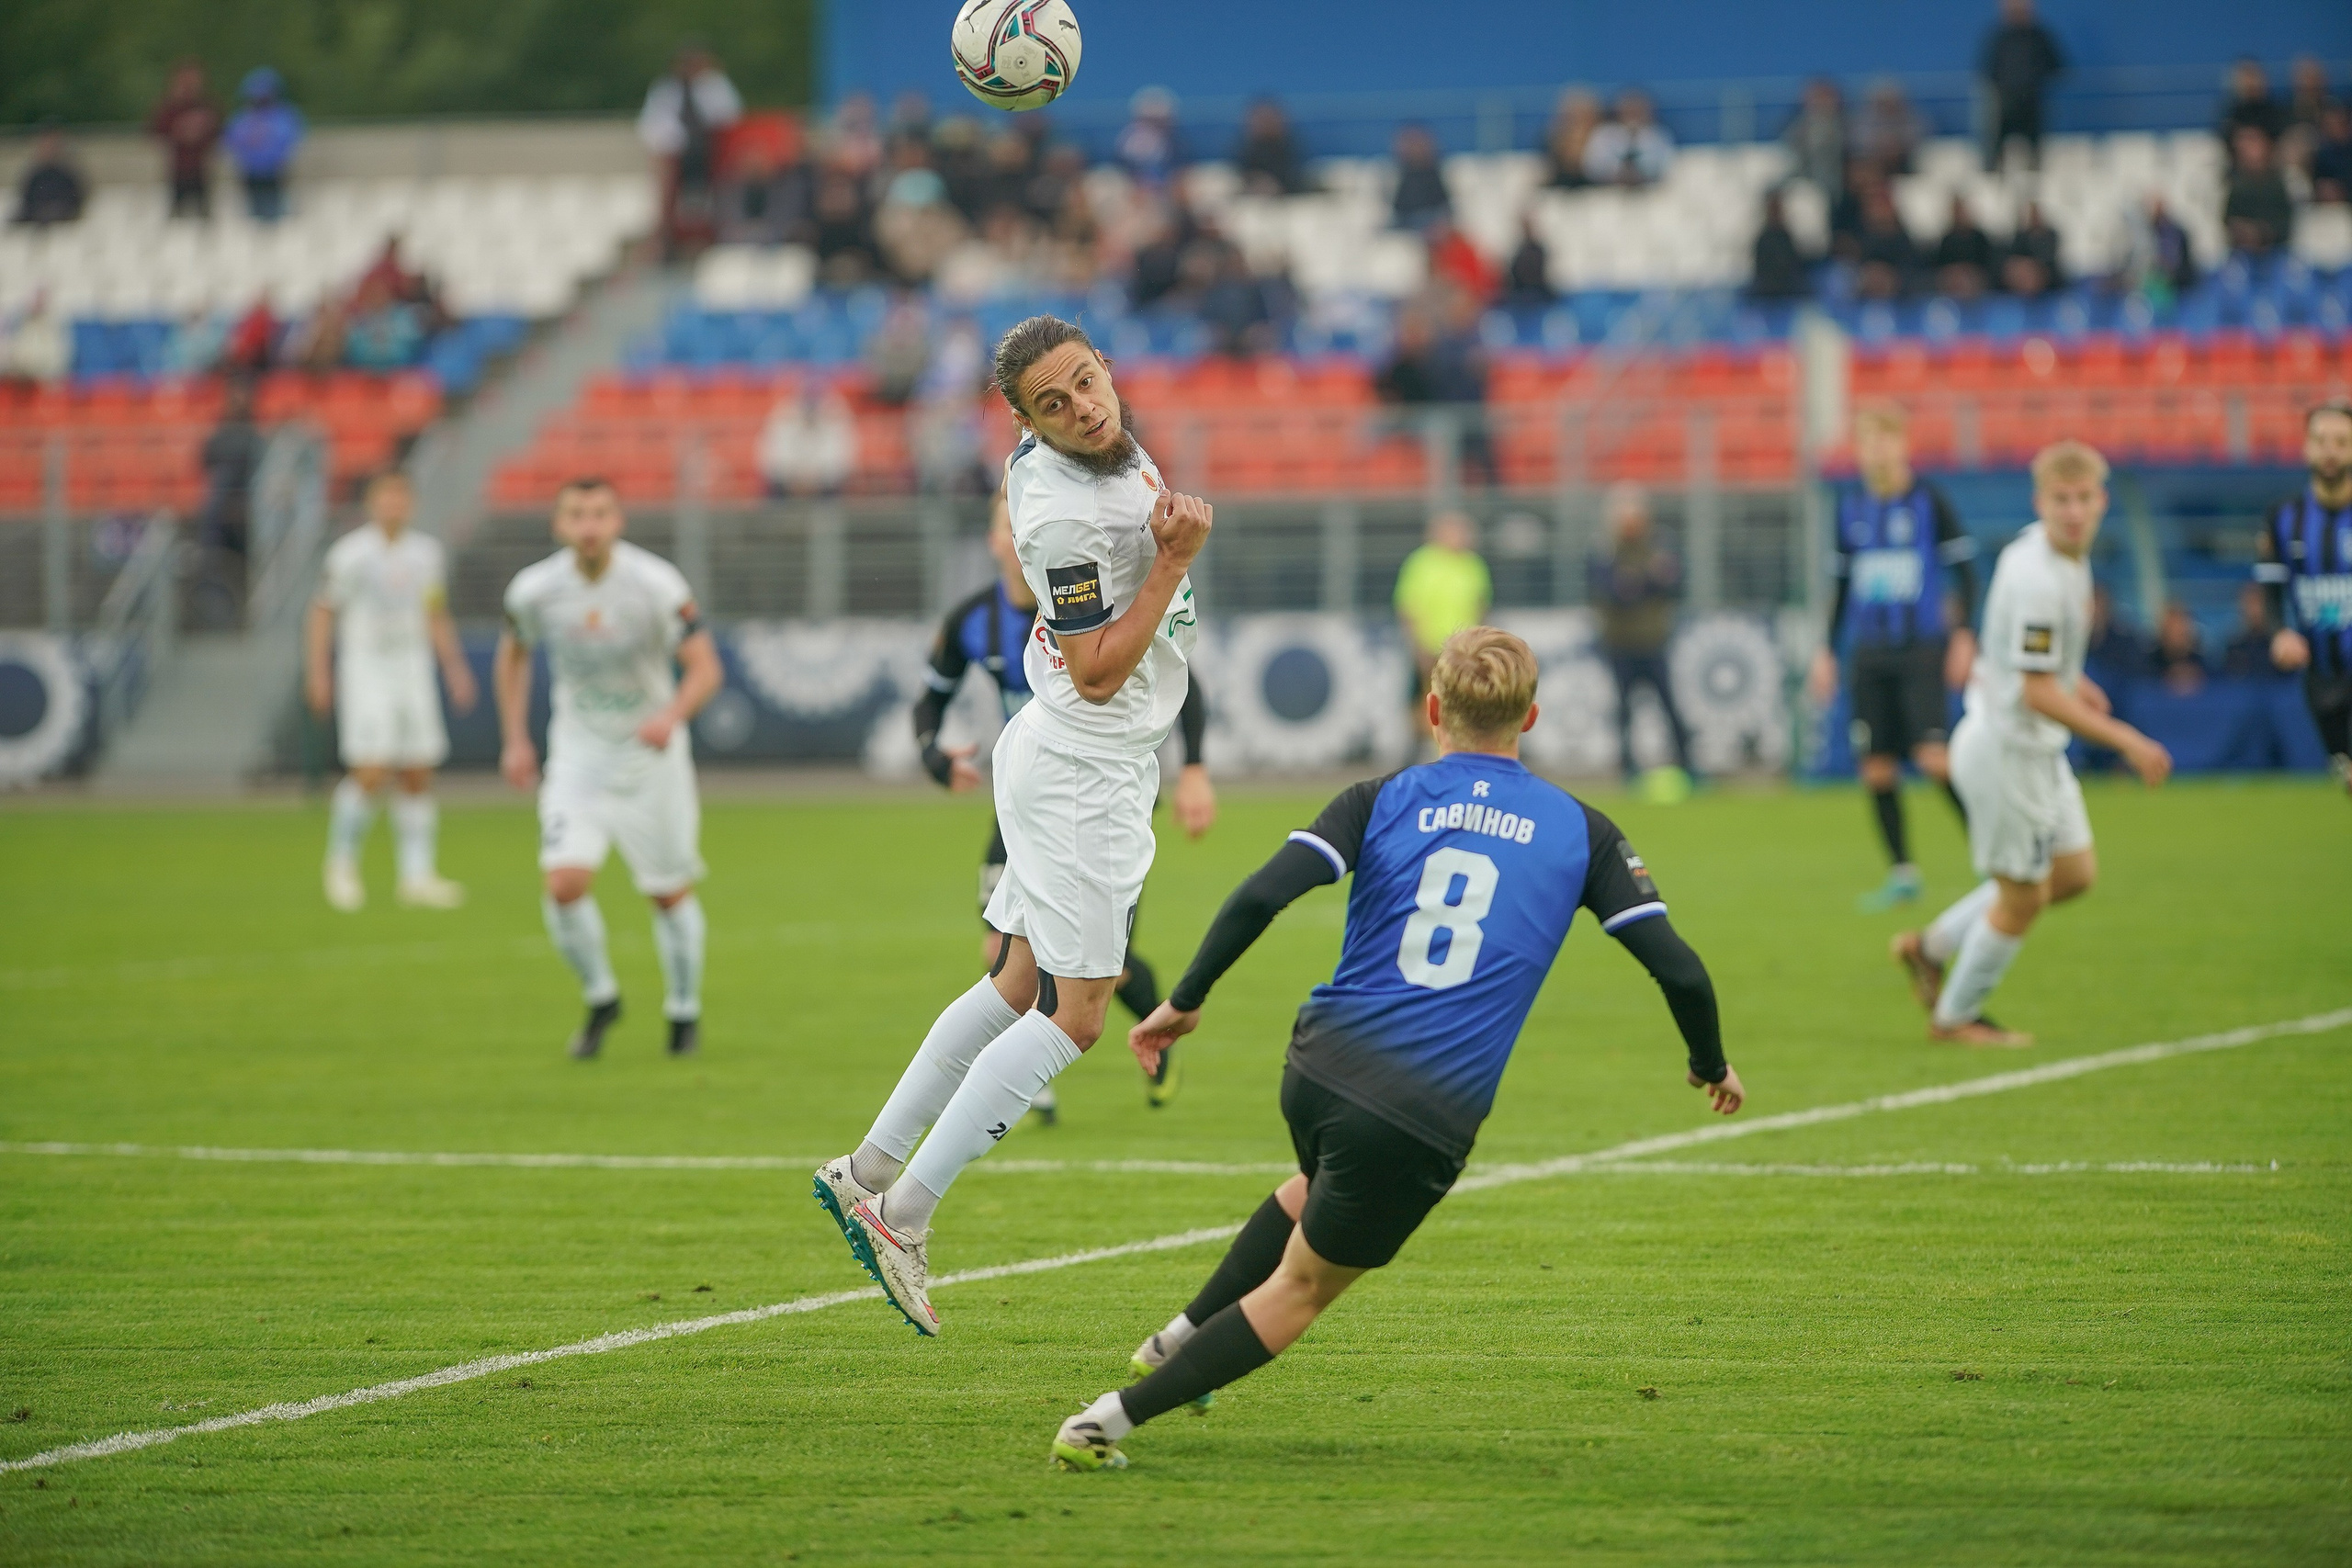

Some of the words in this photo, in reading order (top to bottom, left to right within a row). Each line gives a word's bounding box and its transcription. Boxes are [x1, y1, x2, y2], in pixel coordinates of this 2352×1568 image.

[1052, 579, 1098, 596] МЕЛБЕТ
[1068, 592, 1097, 604] ЛИГА
[1418, 802, 1536, 844] САВИНОВ
[1396, 846, 1501, 991] 8
